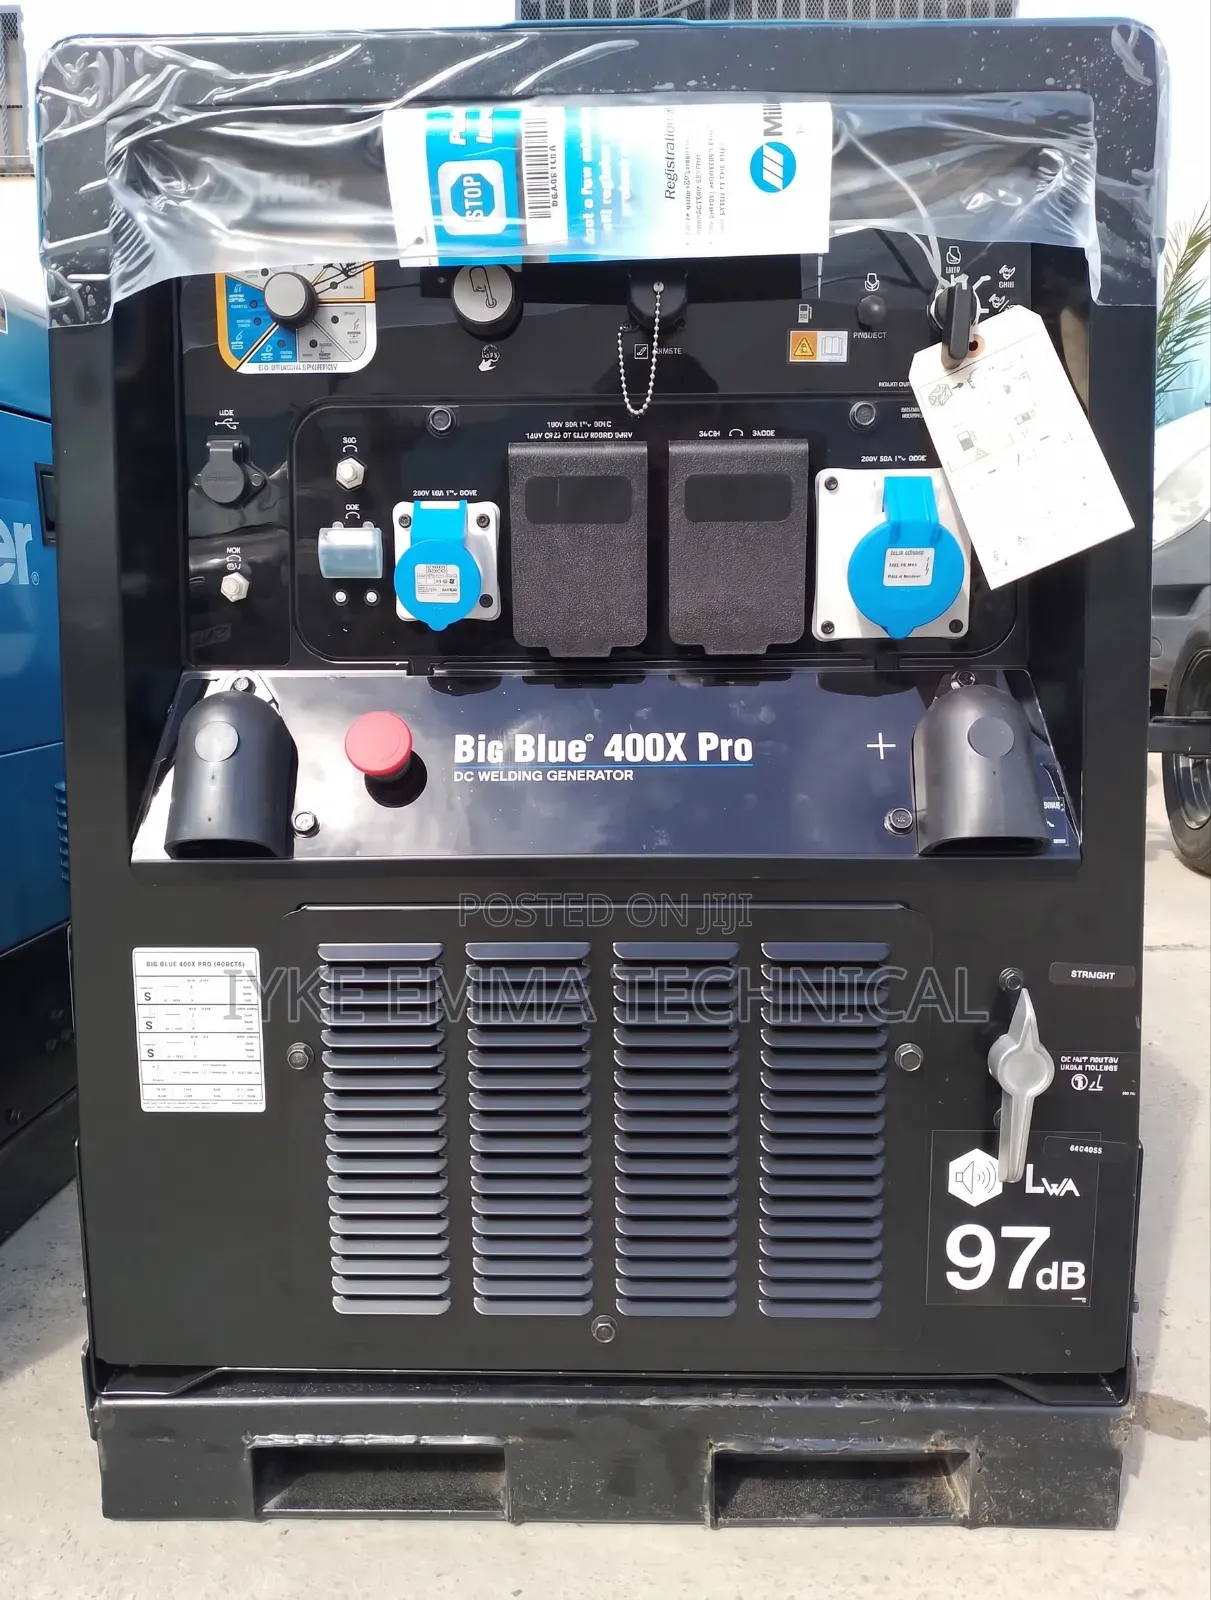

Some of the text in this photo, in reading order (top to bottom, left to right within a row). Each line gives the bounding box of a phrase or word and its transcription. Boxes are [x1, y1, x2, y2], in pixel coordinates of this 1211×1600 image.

[462, 176, 483, 221] STOP
[453, 733, 503, 764] Big
[603, 732, 687, 763] 400X
[698, 732, 753, 763] Pro
[453, 769, 634, 782] DC WELDING GENERATOR
